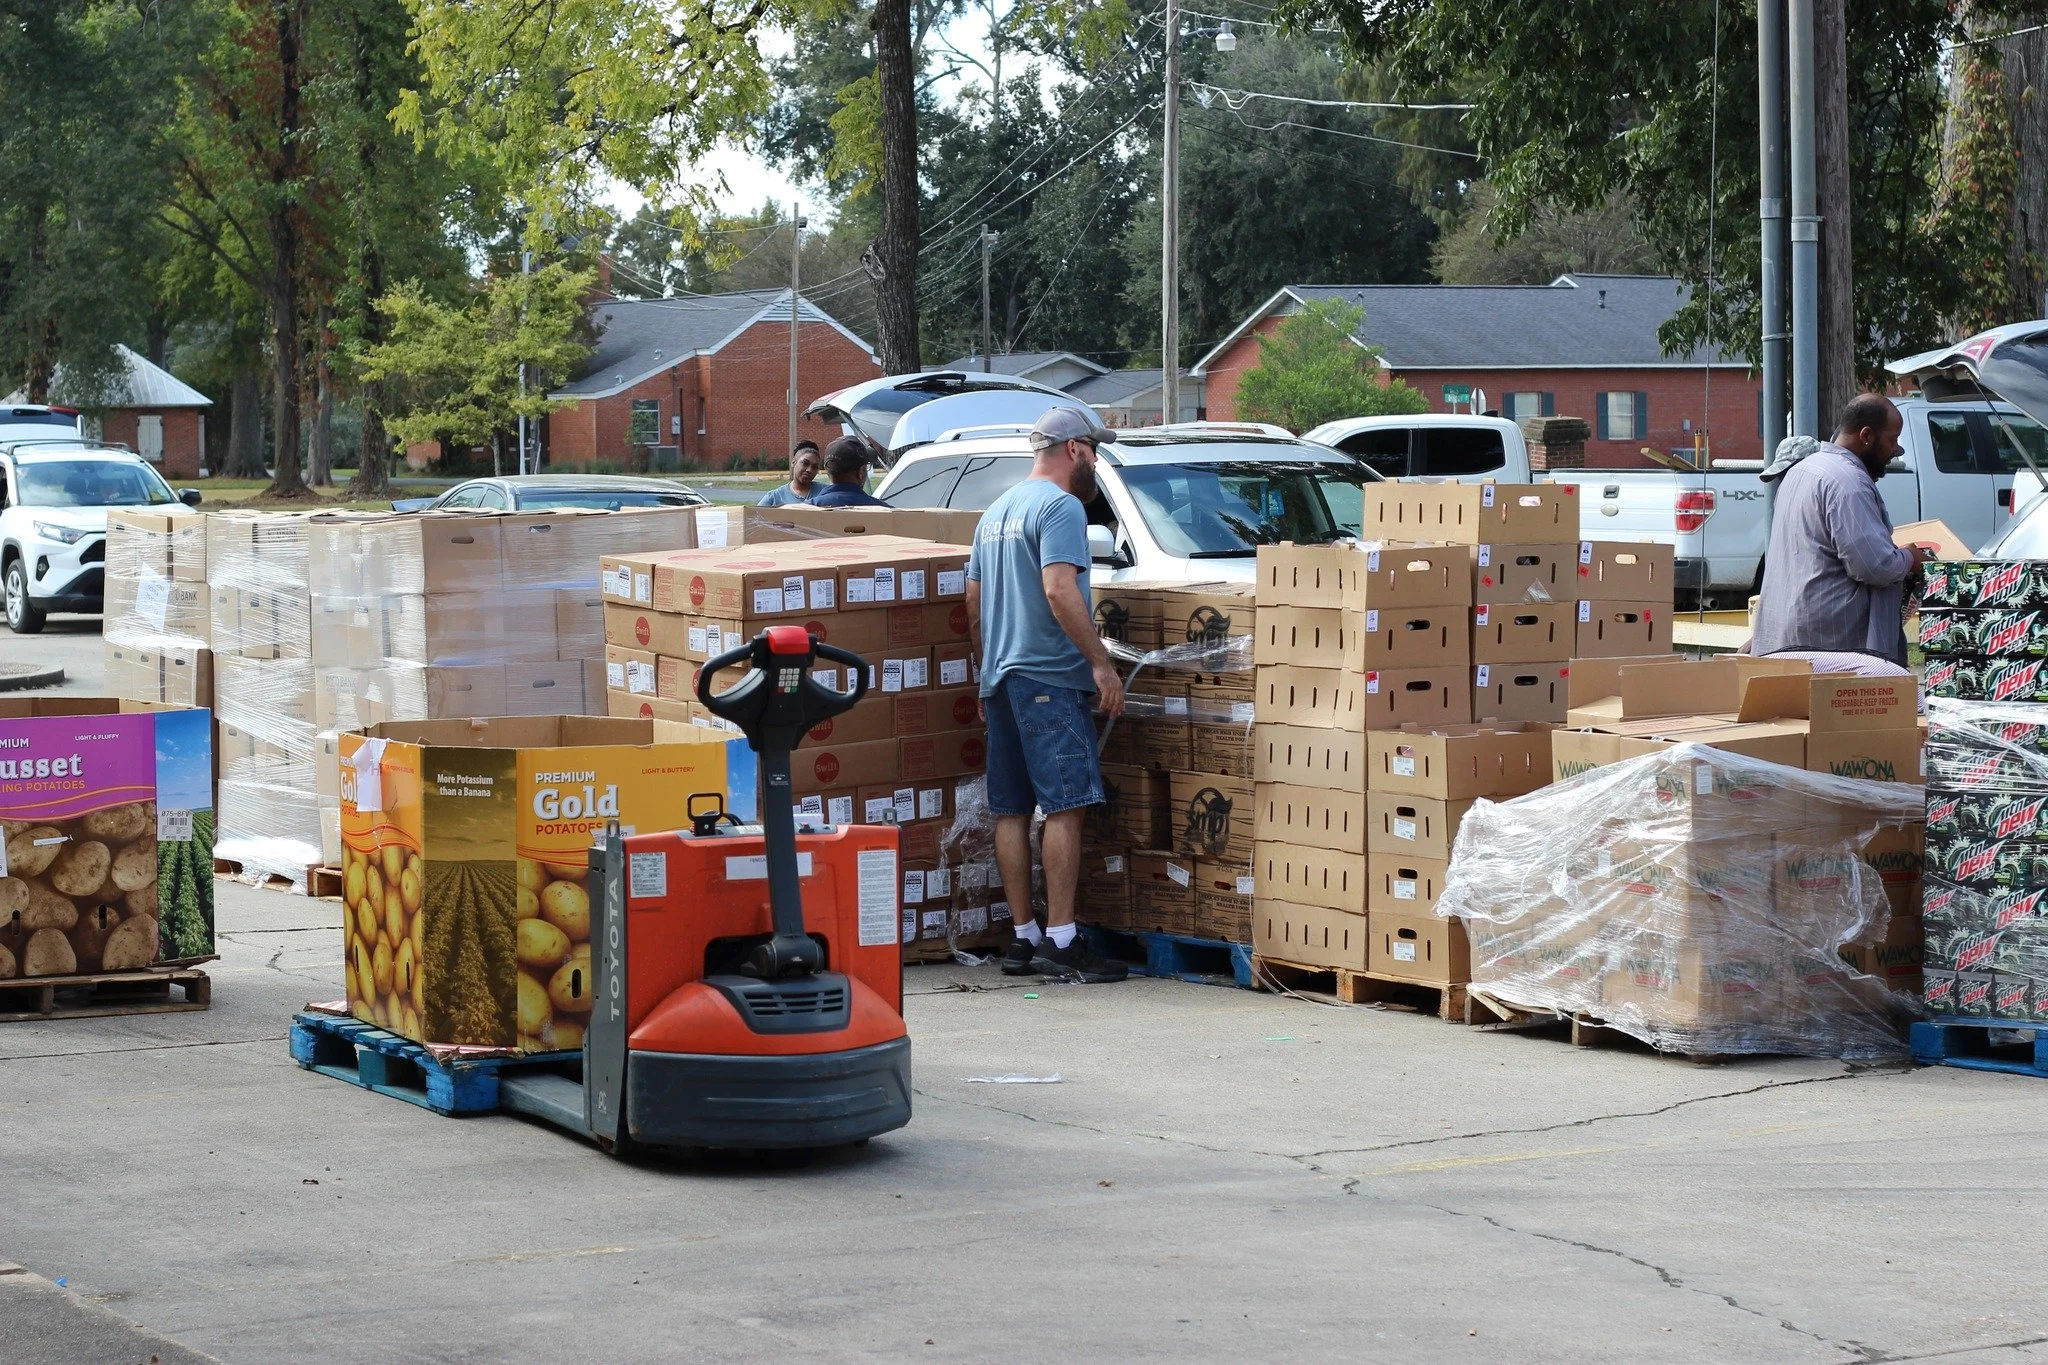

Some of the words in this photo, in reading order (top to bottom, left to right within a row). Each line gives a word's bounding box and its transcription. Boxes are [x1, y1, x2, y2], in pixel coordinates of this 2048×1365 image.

[181, 590, 198, 601] BANK
[690, 585, 704, 594] Swift
[636, 626, 650, 637] Swift
[1836, 688, 1858, 697] OPEN
[1860, 688, 1876, 696] THIS
[1878, 687, 1894, 696] END
[1879, 697, 1899, 706] FROZEN
[0, 738, 29, 748] MIUM
[0, 753, 84, 781] usset
[641, 767, 660, 775] LIGHT
[666, 766, 696, 774] BUTTERY
[816, 761, 838, 773] Swift
[1558, 759, 1598, 779] WAWO
[1829, 758, 1897, 781] WAWONA
[437, 773, 456, 784] More
[456, 774, 494, 785] Potassium
[535, 770, 596, 784] PREMIUM
[1, 782, 22, 793] ING
[26, 780, 86, 792] POTATOES
[341, 771, 358, 804] Gol
[439, 786, 457, 796] than
[457, 788, 462, 796] a
[463, 787, 491, 797] Banana
[533, 784, 621, 821] Gold
[1865, 851, 1924, 874] WAWON
[609, 877, 620, 1021] TOYOTA
[1874, 945, 1923, 967] WAWO
